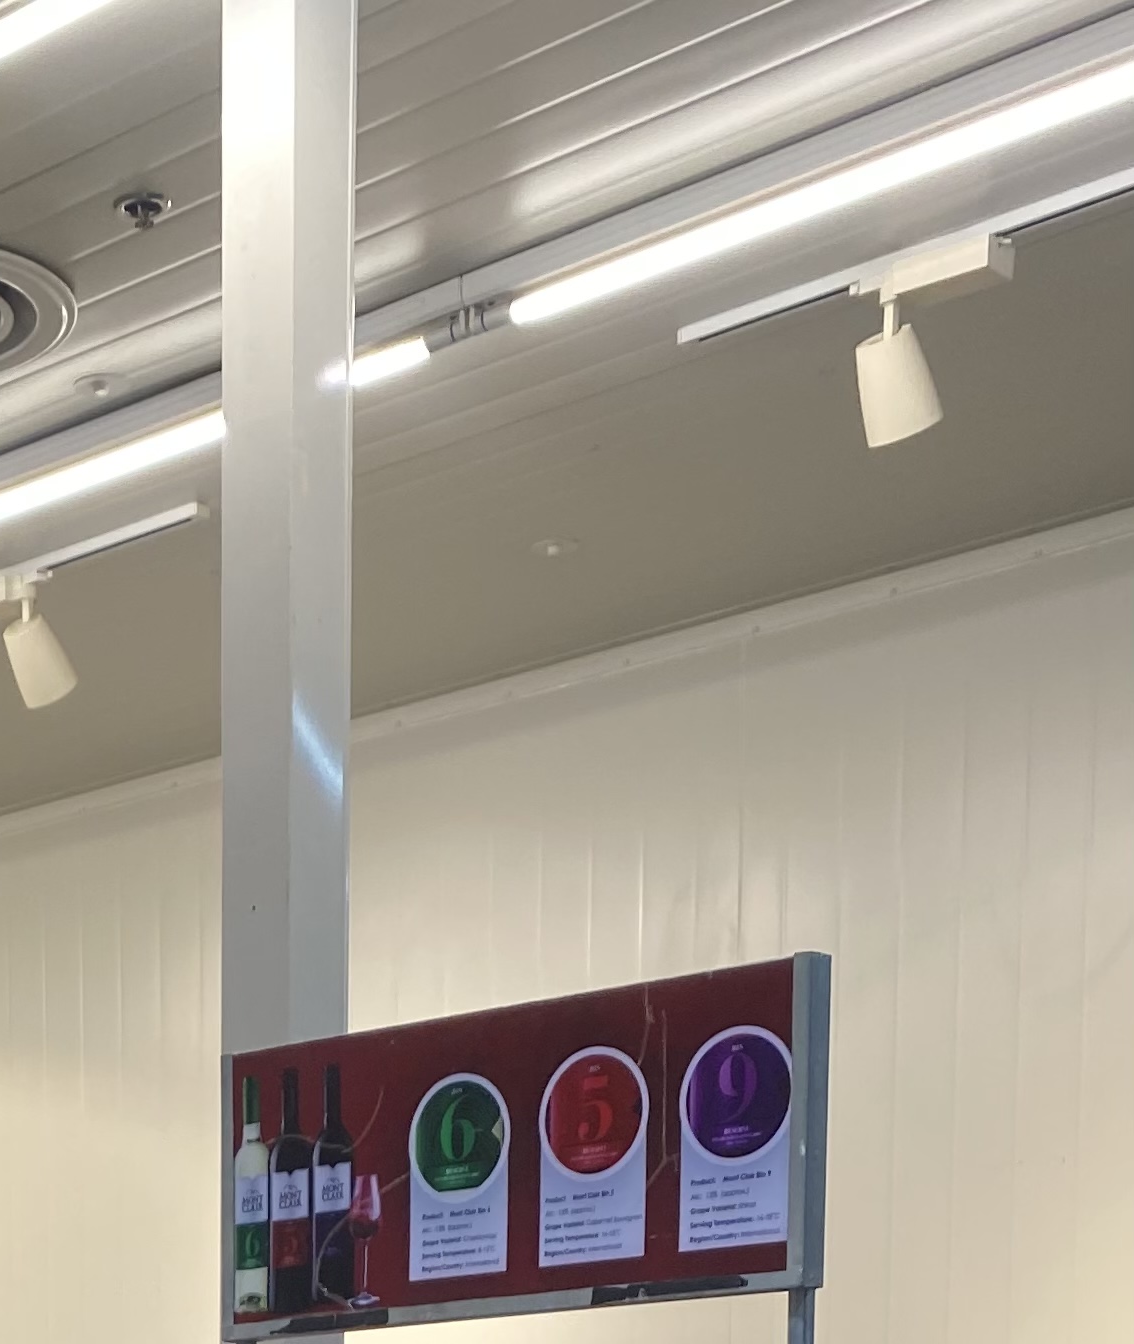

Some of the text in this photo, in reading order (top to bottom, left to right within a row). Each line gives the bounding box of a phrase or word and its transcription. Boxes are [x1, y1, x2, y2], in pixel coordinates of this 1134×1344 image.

[718, 1053, 757, 1124] 9
[578, 1075, 613, 1141] 5
[440, 1094, 477, 1161] 6
[323, 1182, 344, 1194] MONT
[280, 1190, 302, 1202] MONT
[322, 1191, 344, 1202] CLAIR
[242, 1203, 264, 1213] CLAIR
[279, 1200, 302, 1209] CLAIR
